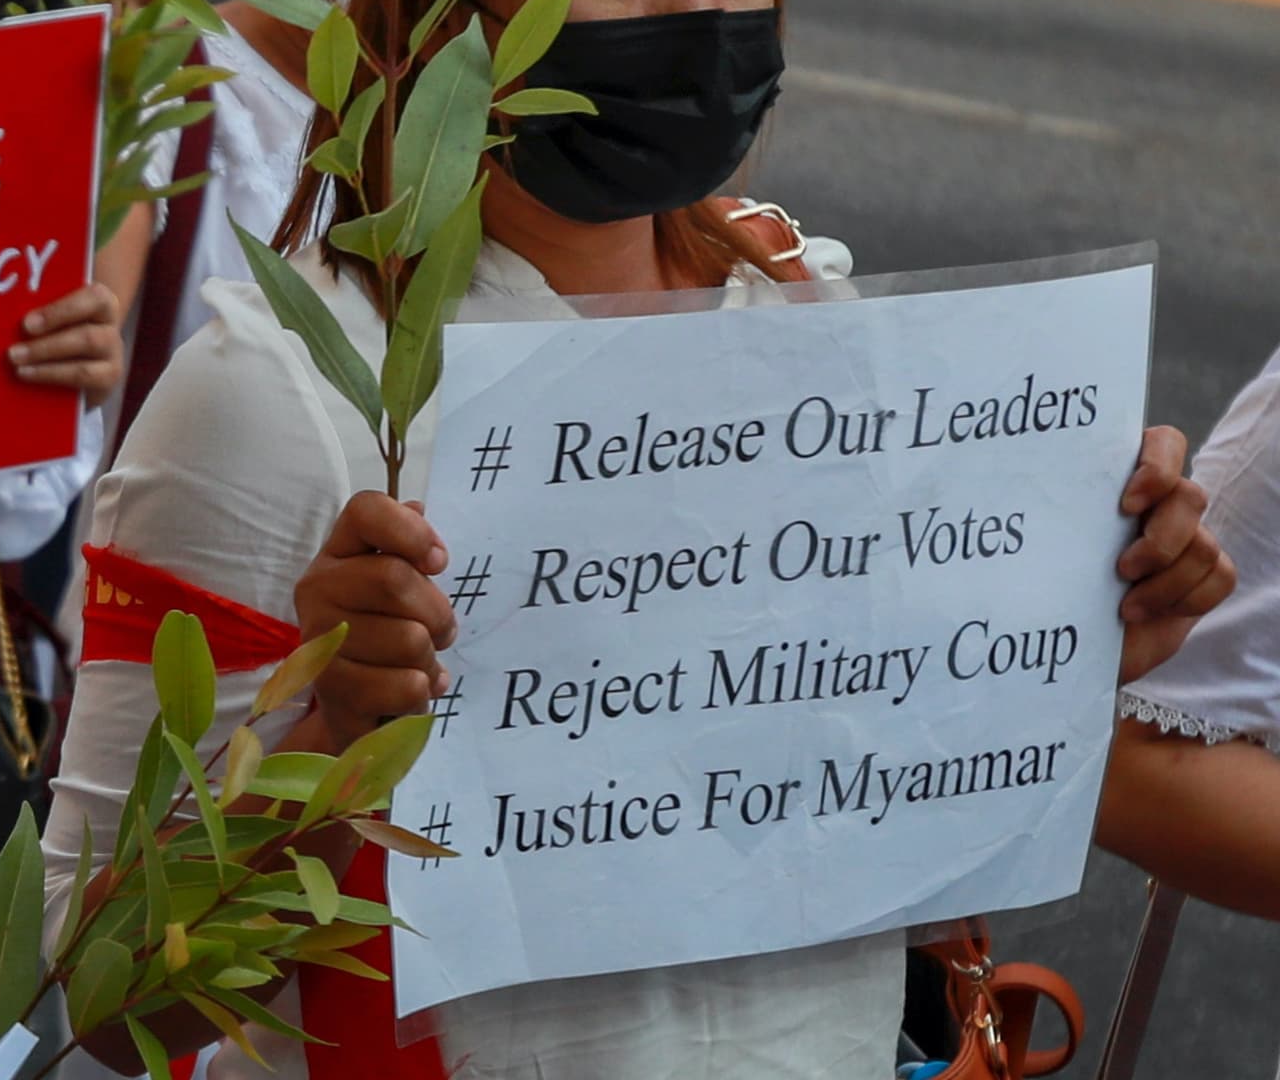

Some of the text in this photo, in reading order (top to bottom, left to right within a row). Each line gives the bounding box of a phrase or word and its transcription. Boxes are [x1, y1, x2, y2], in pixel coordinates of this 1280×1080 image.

[471, 374, 1099, 492] # Release Our Leaders
[449, 505, 1026, 616] # Respect Our Votes
[494, 659, 688, 741] Reject
[701, 640, 932, 710] Military
[947, 619, 1079, 685] Coup
[484, 779, 681, 858] Justice
[697, 768, 802, 832] For
[812, 737, 1067, 826] Myanmar
